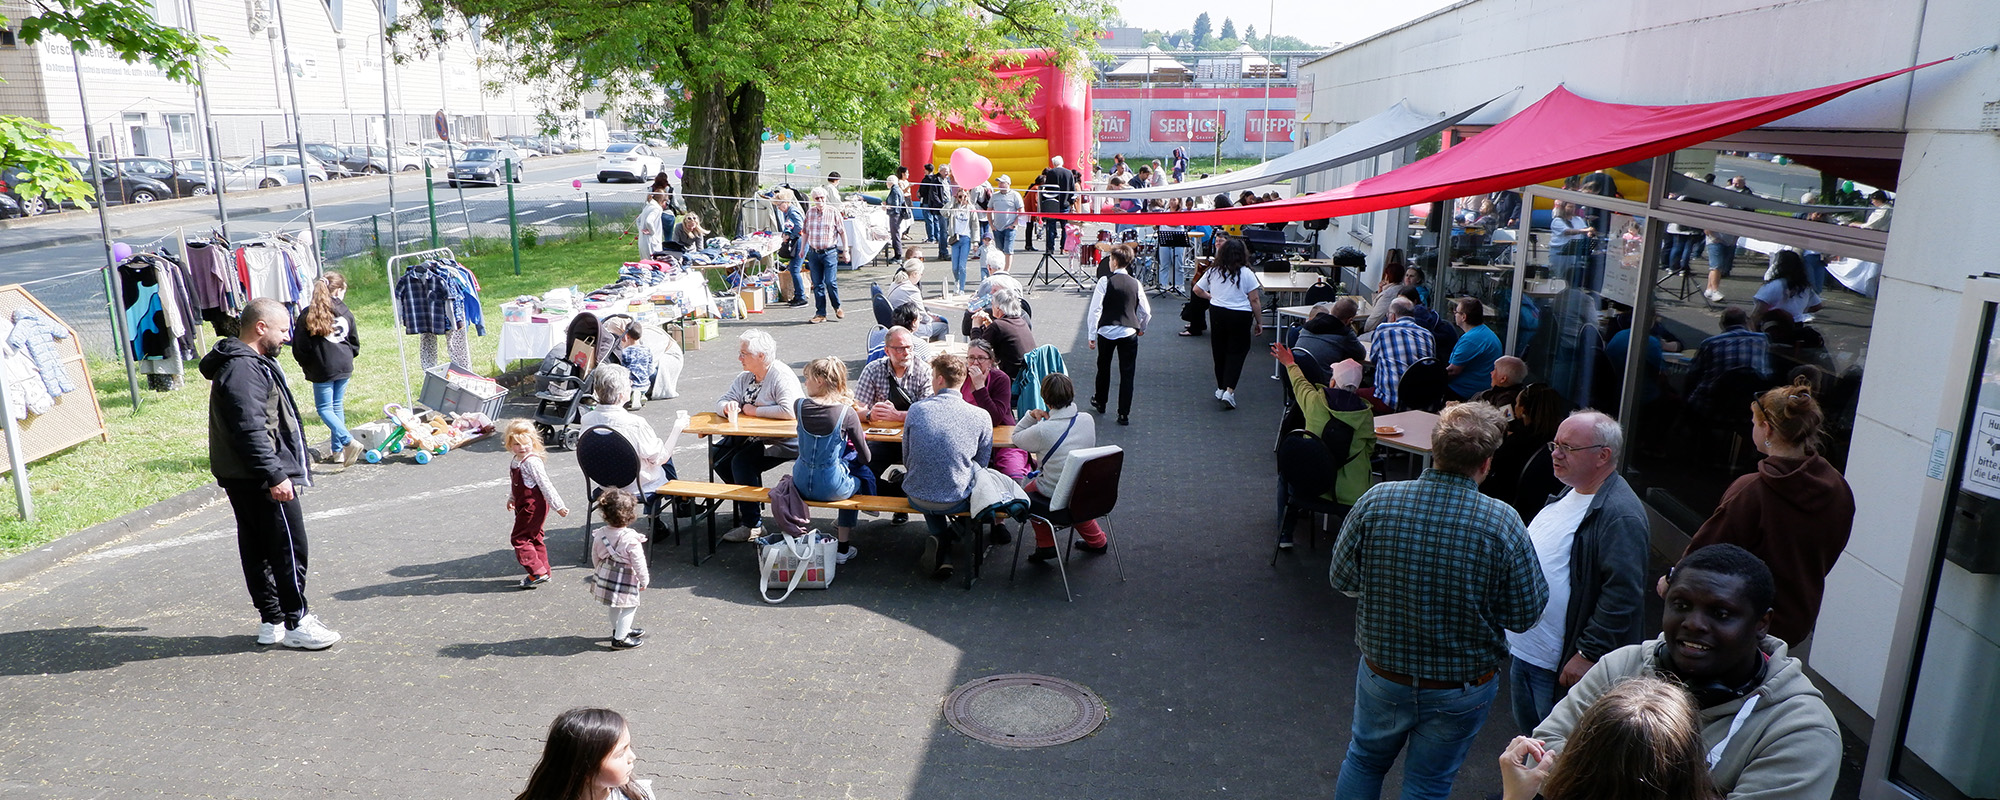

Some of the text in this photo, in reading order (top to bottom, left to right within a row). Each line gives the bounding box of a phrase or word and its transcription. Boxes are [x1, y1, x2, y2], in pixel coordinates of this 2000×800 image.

[1159, 118, 1217, 133] SERVICE
[1978, 456, 1997, 470] bitte
[1974, 467, 1986, 479] die
